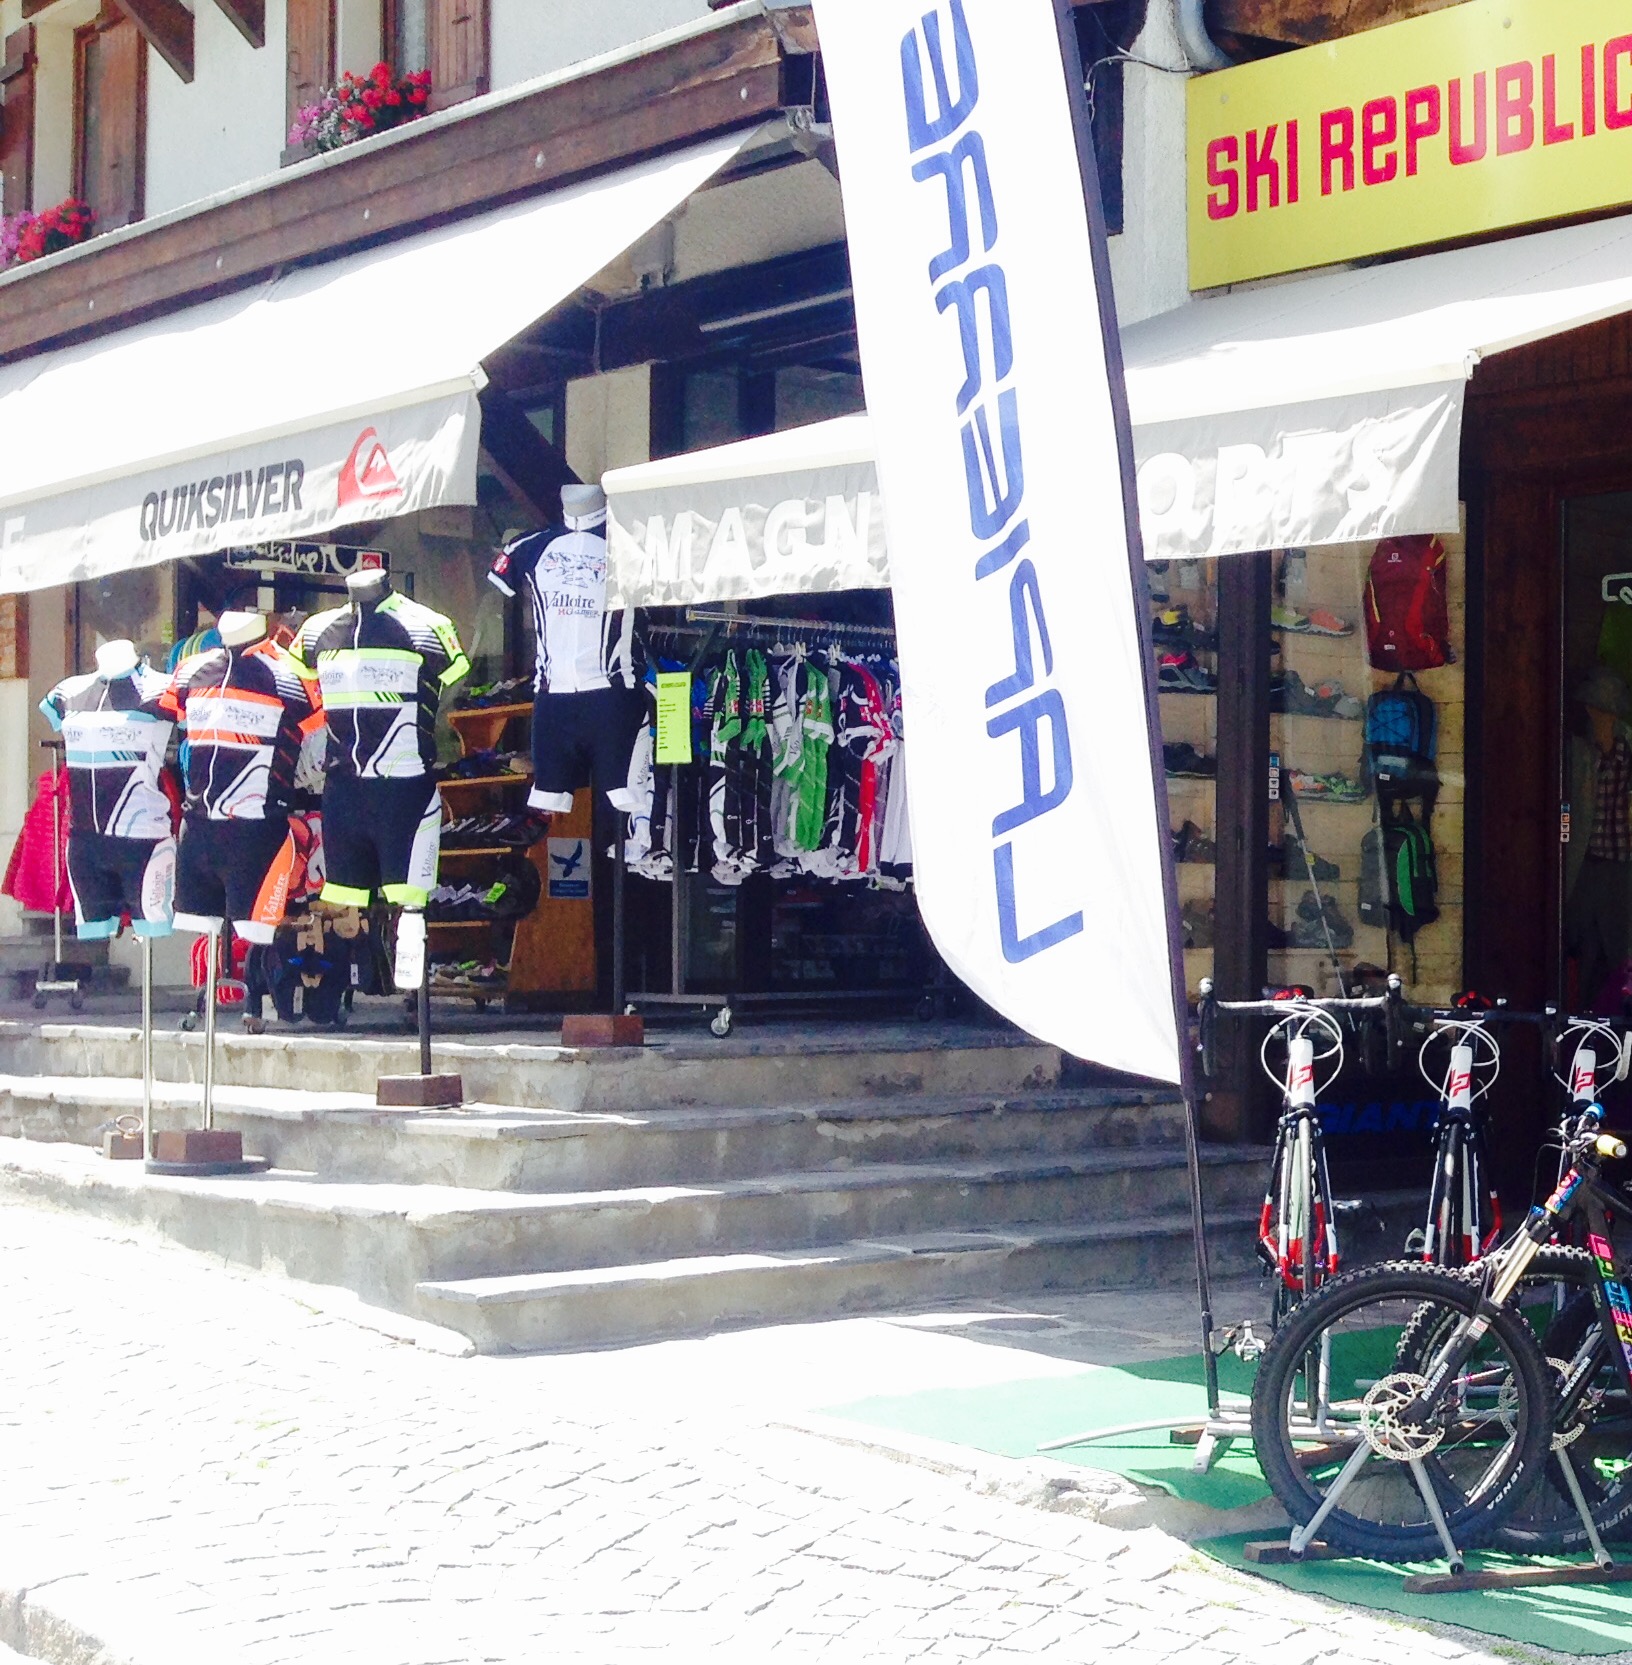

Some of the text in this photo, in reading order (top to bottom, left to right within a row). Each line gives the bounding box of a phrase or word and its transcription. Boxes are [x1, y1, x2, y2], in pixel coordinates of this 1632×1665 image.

[1206, 119, 1299, 221] SKI
[139, 458, 305, 542] QUIKSILVER
[542, 591, 595, 611] Valloire
[260, 872, 286, 921] Valloire
[1486, 1460, 1525, 1510] KENDA
